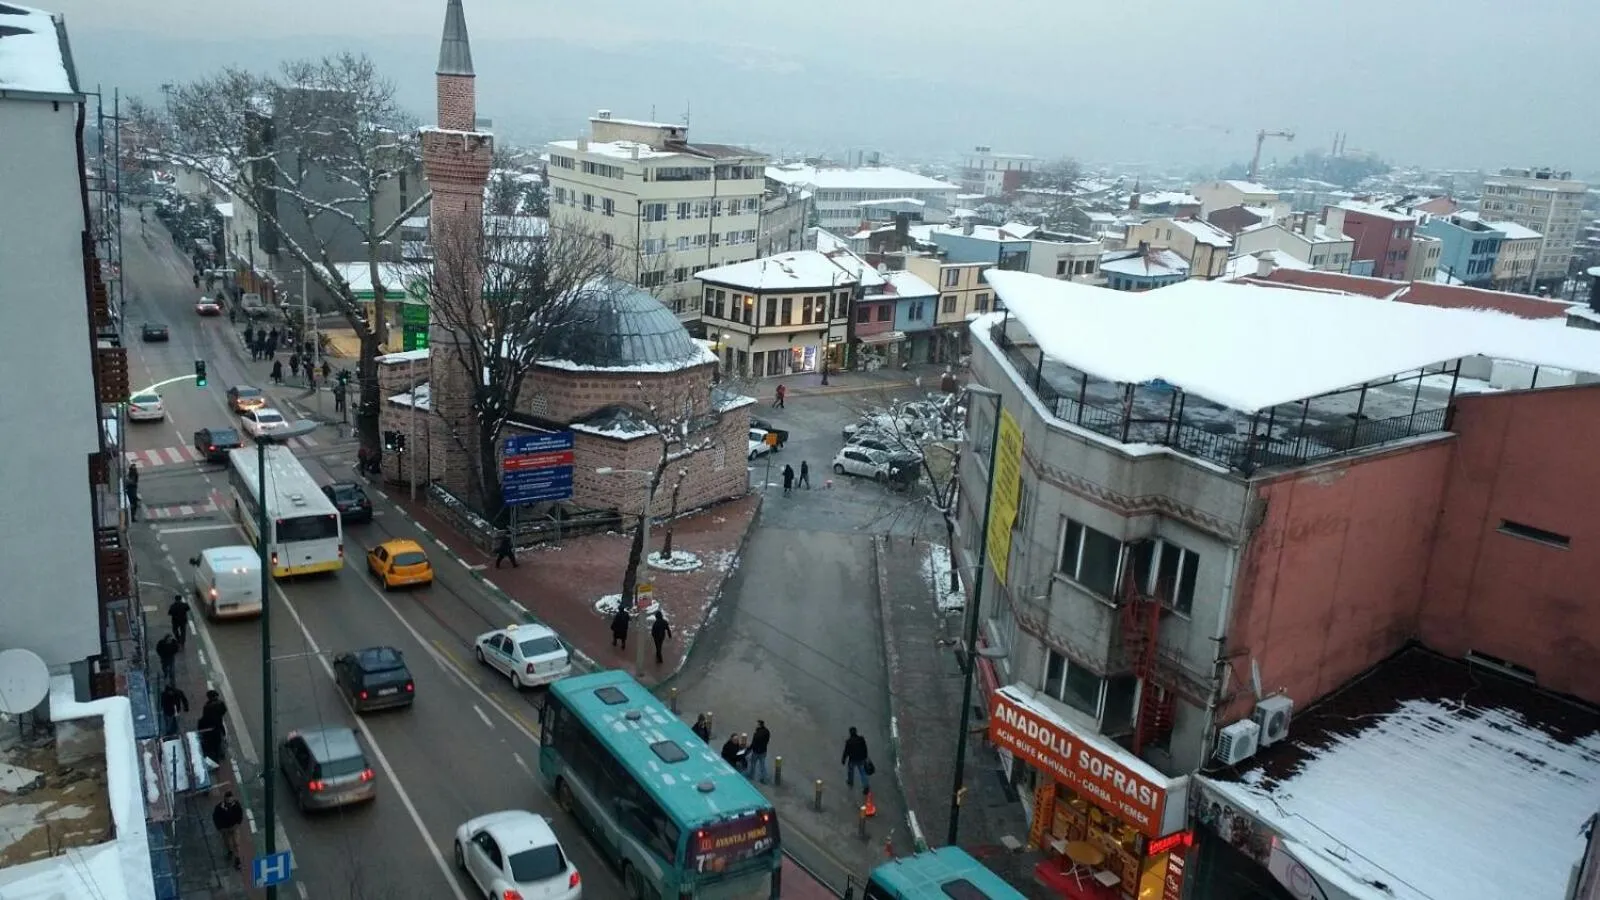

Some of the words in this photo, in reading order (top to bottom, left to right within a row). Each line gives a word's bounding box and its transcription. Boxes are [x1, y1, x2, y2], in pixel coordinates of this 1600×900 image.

[995, 703, 1072, 759] ANADOLU
[1079, 750, 1158, 811] SOFRASI
[1037, 751, 1076, 783] KAHVALTI
[1119, 800, 1149, 825] YEMEK
[260, 854, 285, 882] H
